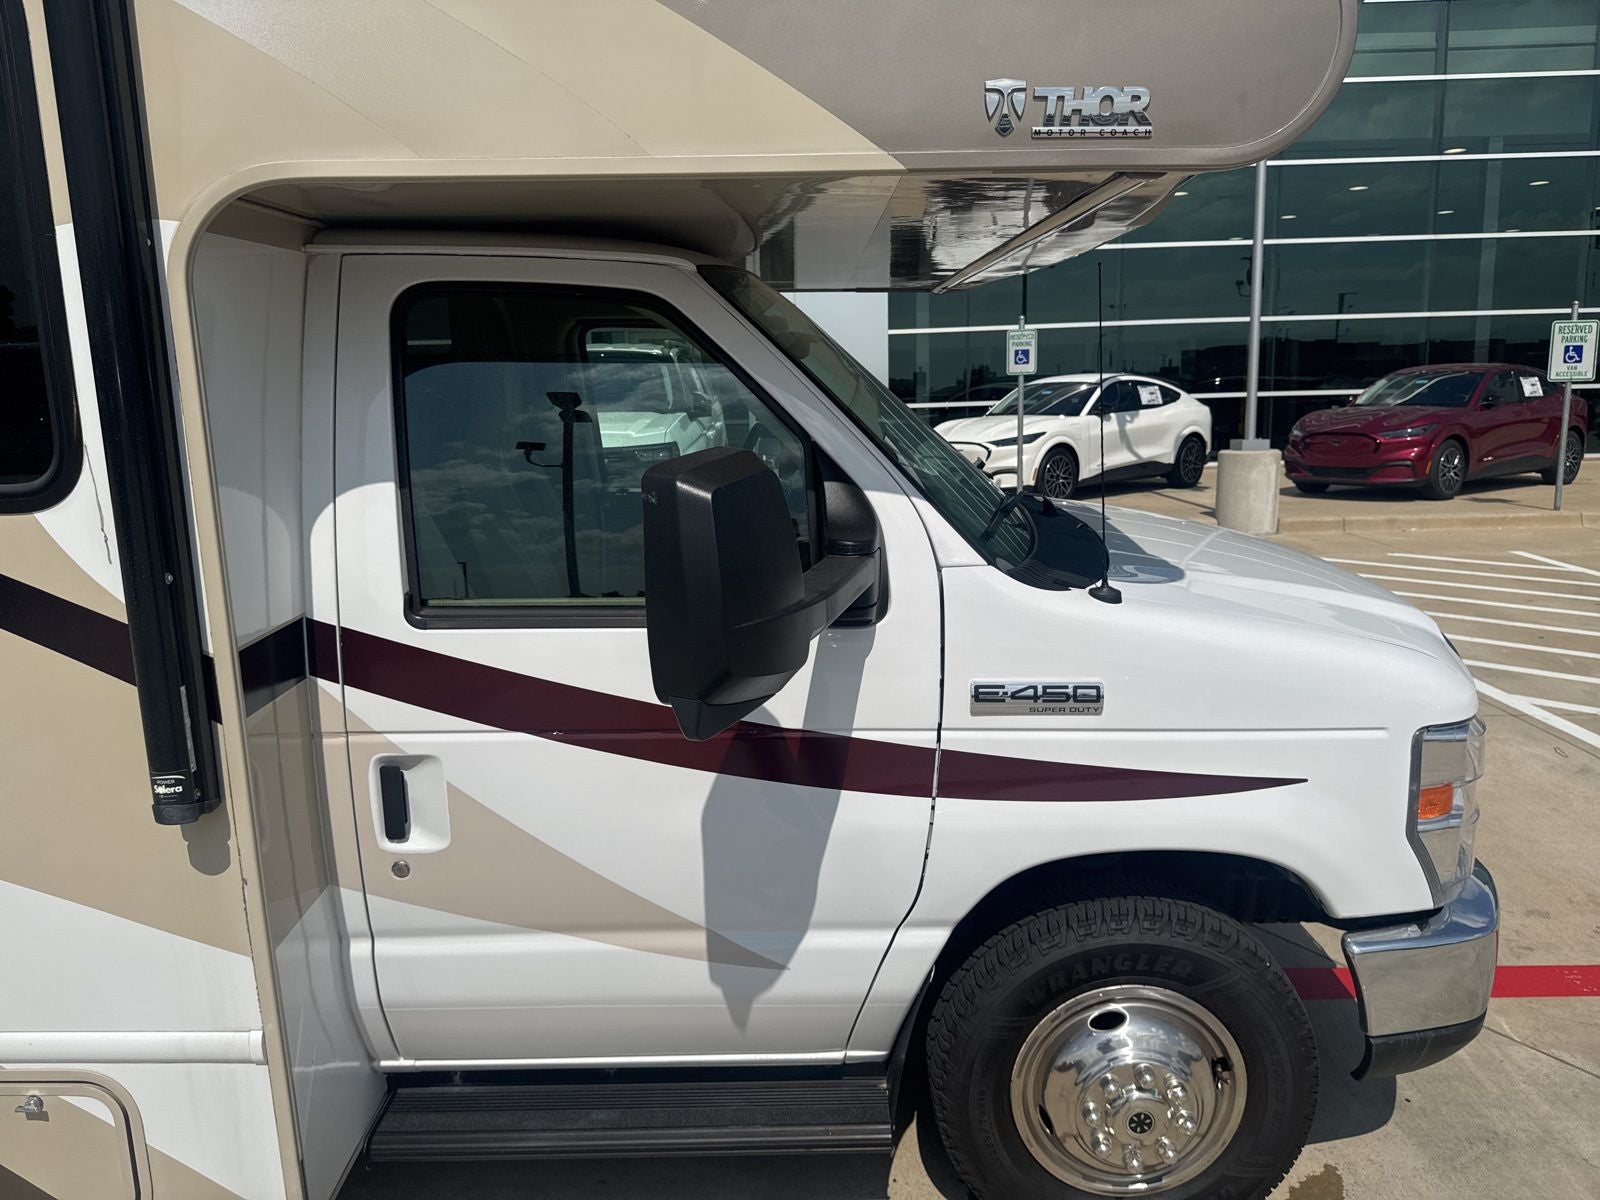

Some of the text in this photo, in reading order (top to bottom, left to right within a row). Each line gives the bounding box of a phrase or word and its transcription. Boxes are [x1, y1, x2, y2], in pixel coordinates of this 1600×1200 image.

[1033, 86, 1152, 127] THOR
[1033, 129, 1152, 137] MOTOR COACH
[1558, 325, 1593, 334] RESERVED
[1561, 335, 1588, 343] PARKING
[973, 685, 1101, 703] E-450
[153, 785, 183, 794] Solera
[1022, 953, 1193, 1006] WRANGLER
